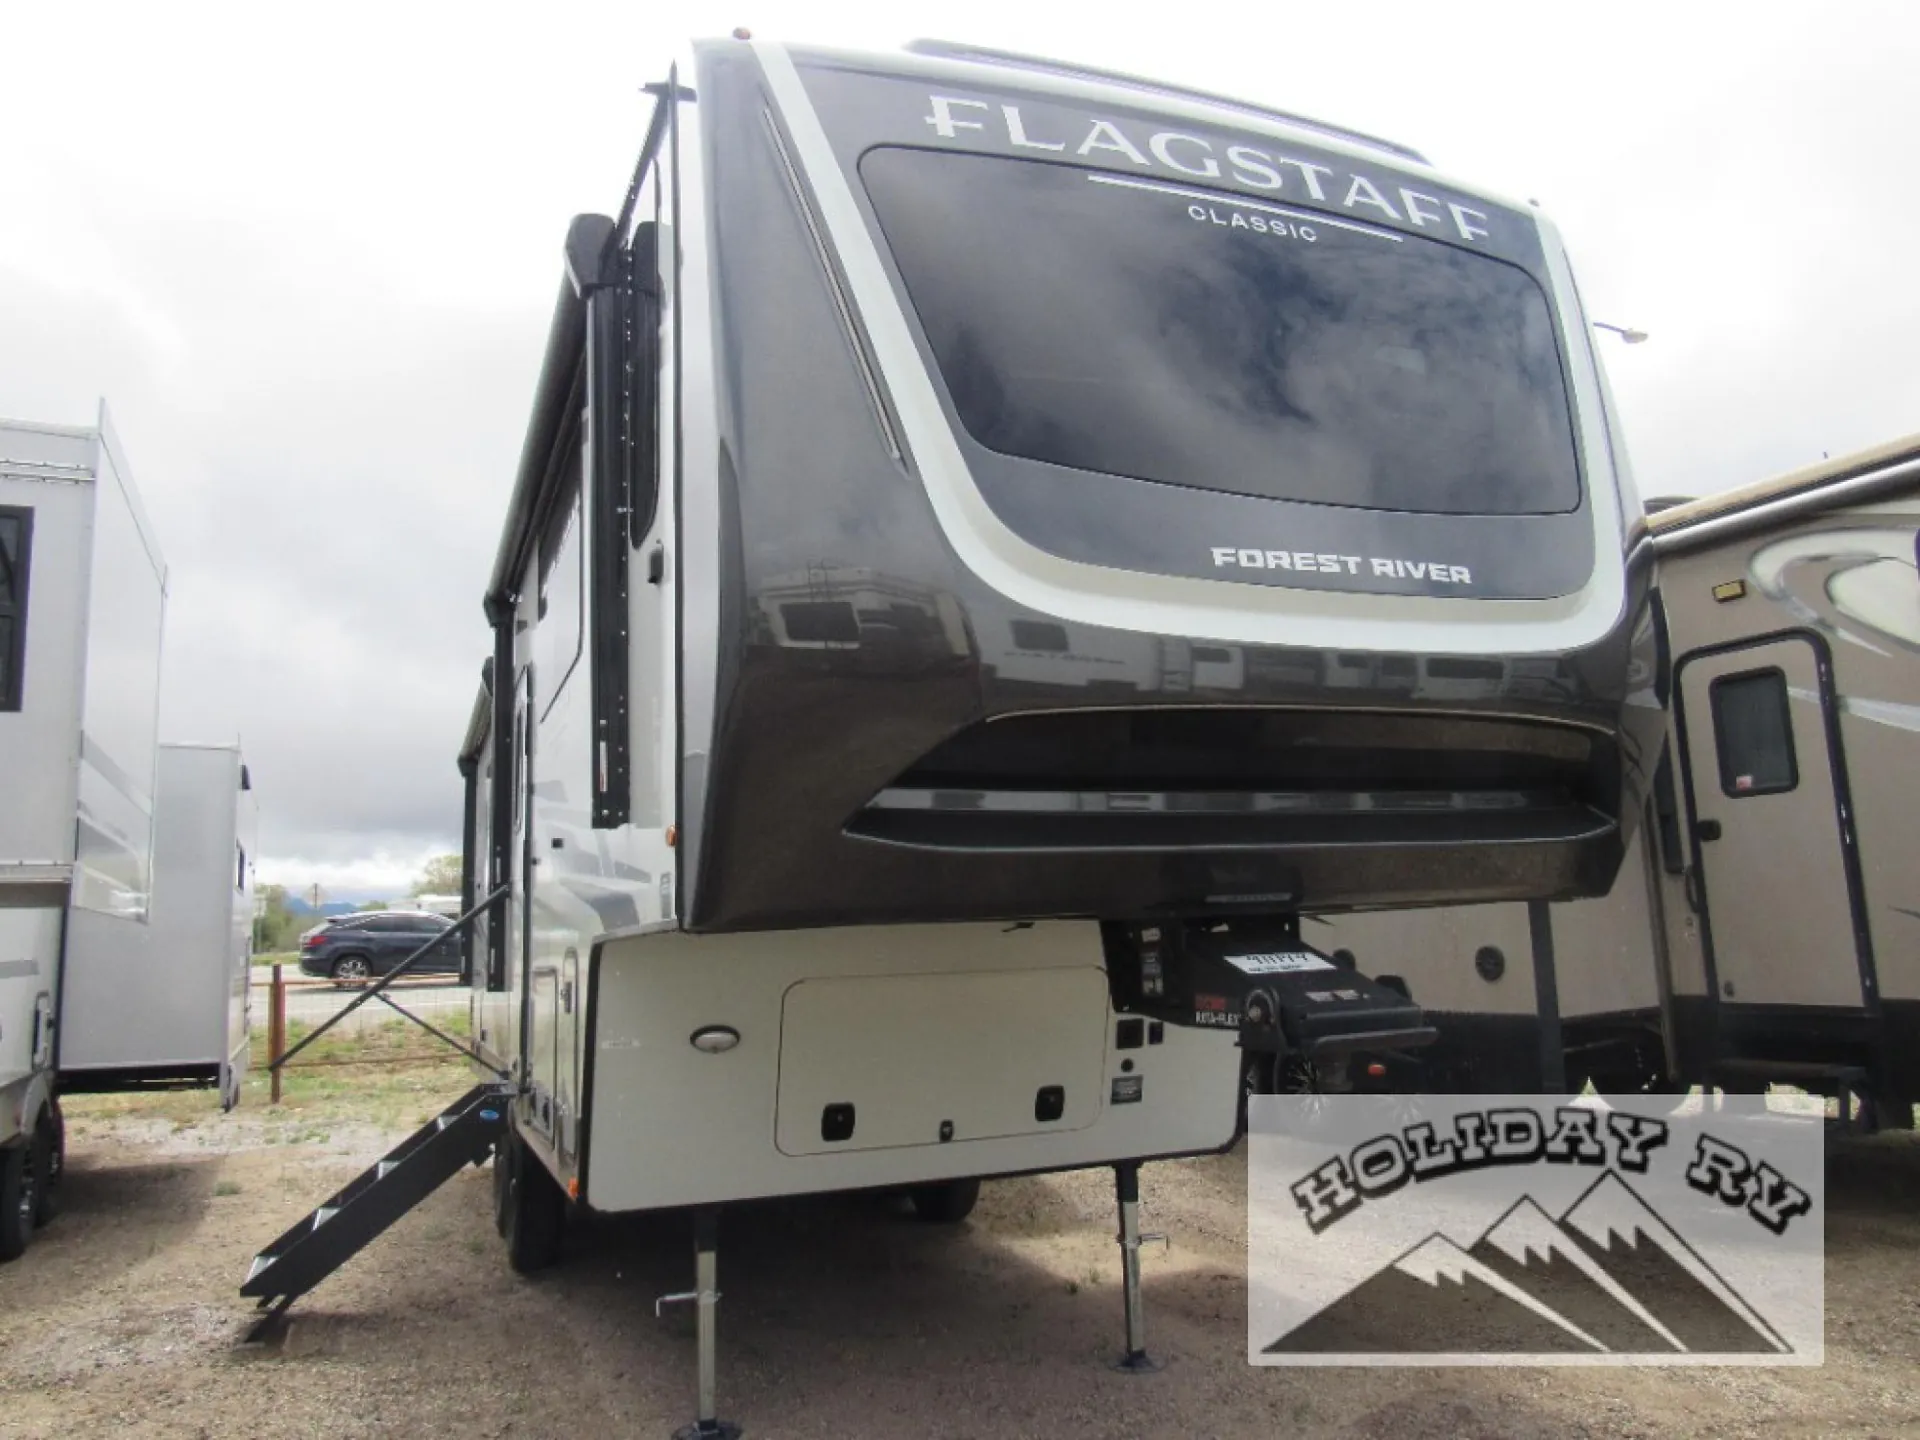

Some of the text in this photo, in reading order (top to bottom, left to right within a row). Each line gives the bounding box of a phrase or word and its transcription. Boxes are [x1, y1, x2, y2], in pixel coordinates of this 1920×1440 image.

[925, 95, 1489, 242] FLAGSTAFF
[1188, 205, 1318, 243] CLASSIC
[1210, 547, 1473, 584] FOREST RIVER
